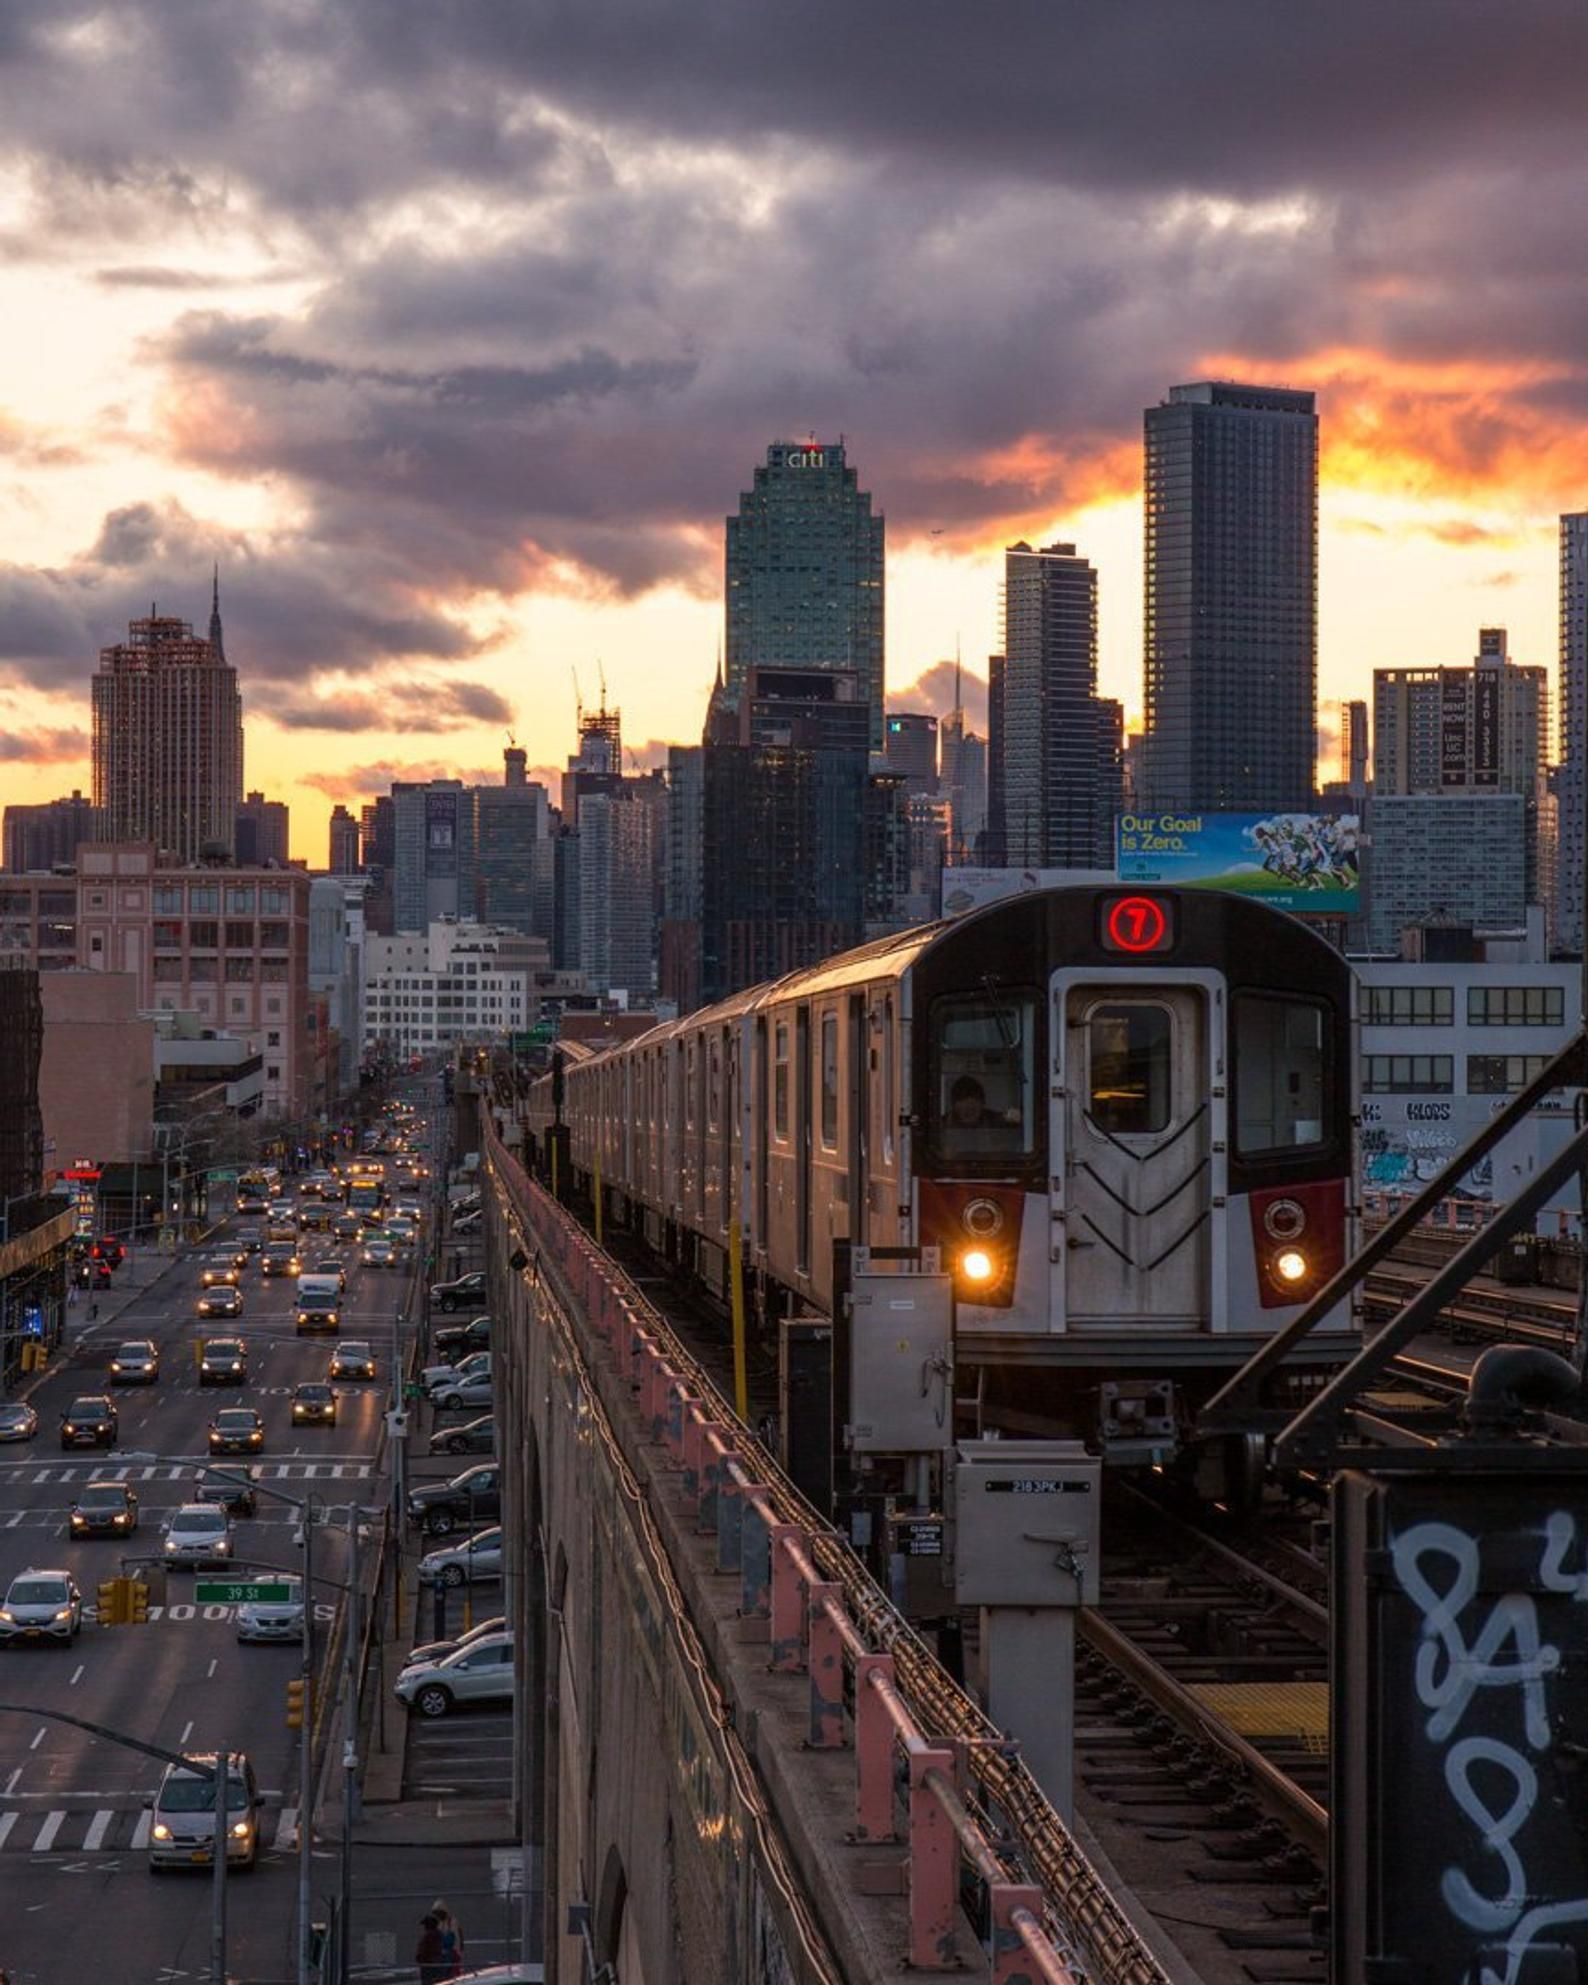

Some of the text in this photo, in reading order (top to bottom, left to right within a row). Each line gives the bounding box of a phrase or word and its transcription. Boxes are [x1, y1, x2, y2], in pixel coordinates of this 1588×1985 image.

[788, 450, 823, 468] citi
[1478, 673, 1496, 682] 718
[1121, 816, 1202, 832] Our Goal
[1121, 833, 1187, 849] is Zero.
[1128, 908, 1147, 940] 7
[227, 1587, 243, 1600] 39
